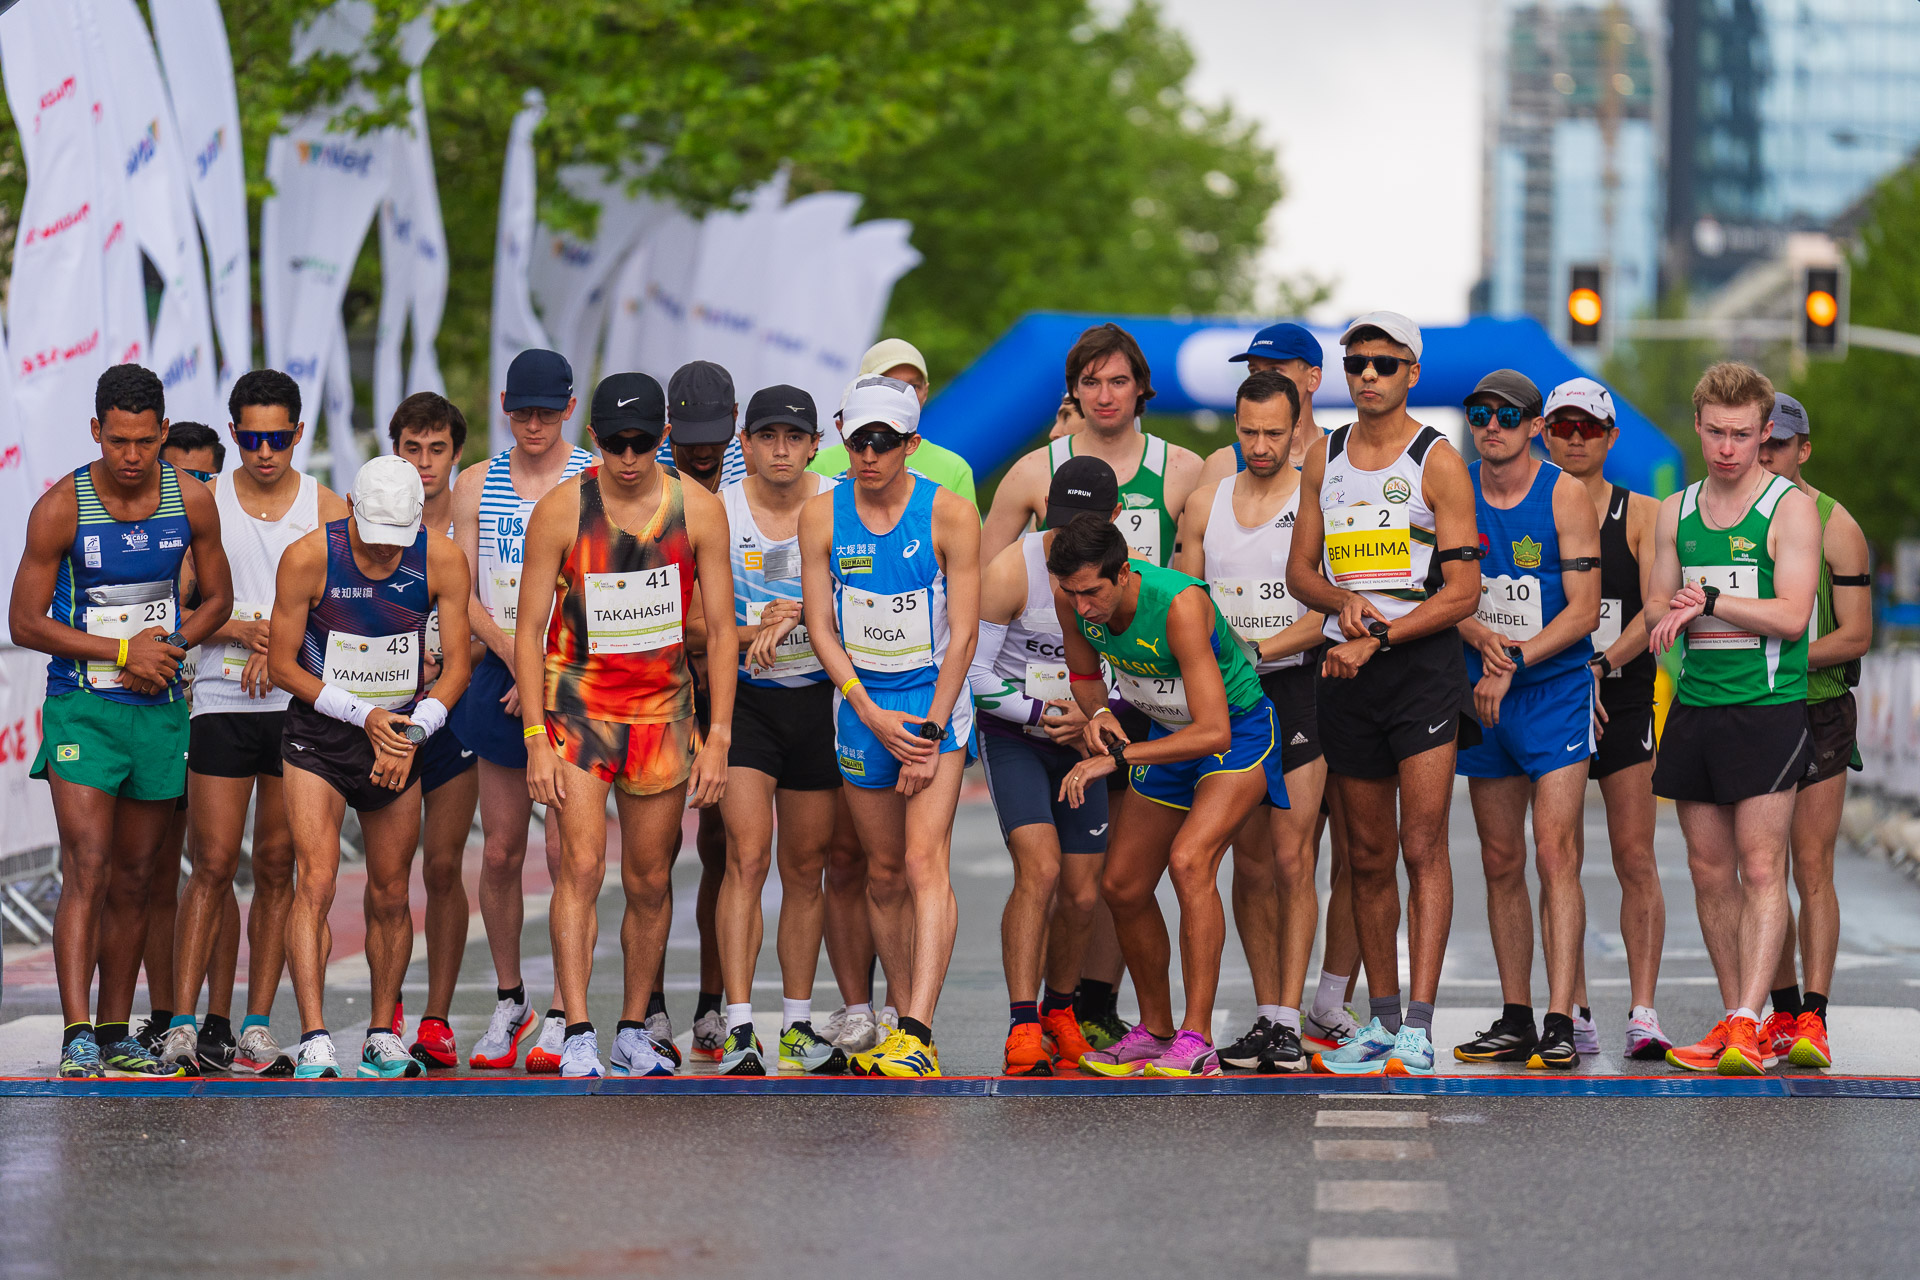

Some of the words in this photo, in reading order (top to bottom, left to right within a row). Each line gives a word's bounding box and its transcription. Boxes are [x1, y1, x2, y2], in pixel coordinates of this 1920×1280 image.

[1067, 488, 1092, 498] KIPRUN
[1387, 481, 1407, 491] RKS
[498, 517, 525, 537] US
[1130, 514, 1142, 532] 9
[1378, 509, 1391, 528] 2
[159, 540, 183, 549] BRASIL
[1328, 545, 1350, 561] BEN
[1354, 541, 1409, 558] HLIMA
[646, 569, 670, 589] 41
[1728, 571, 1739, 589] 1
[1259, 582, 1286, 601] 38
[1505, 584, 1530, 601] 10
[144, 603, 167, 622] 23
[594, 601, 674, 622] TAKAHASHI
[892, 593, 917, 614] 35
[1222, 615, 1293, 629] ULGRIEZIS
[1476, 608, 1529, 626] SCHIEDEL
[863, 625, 906, 642] KOGA
[387, 636, 409, 655] 43
[332, 668, 410, 683] YAMANISHI
[1153, 679, 1176, 694] 27
[1134, 699, 1184, 717] BONFIM
